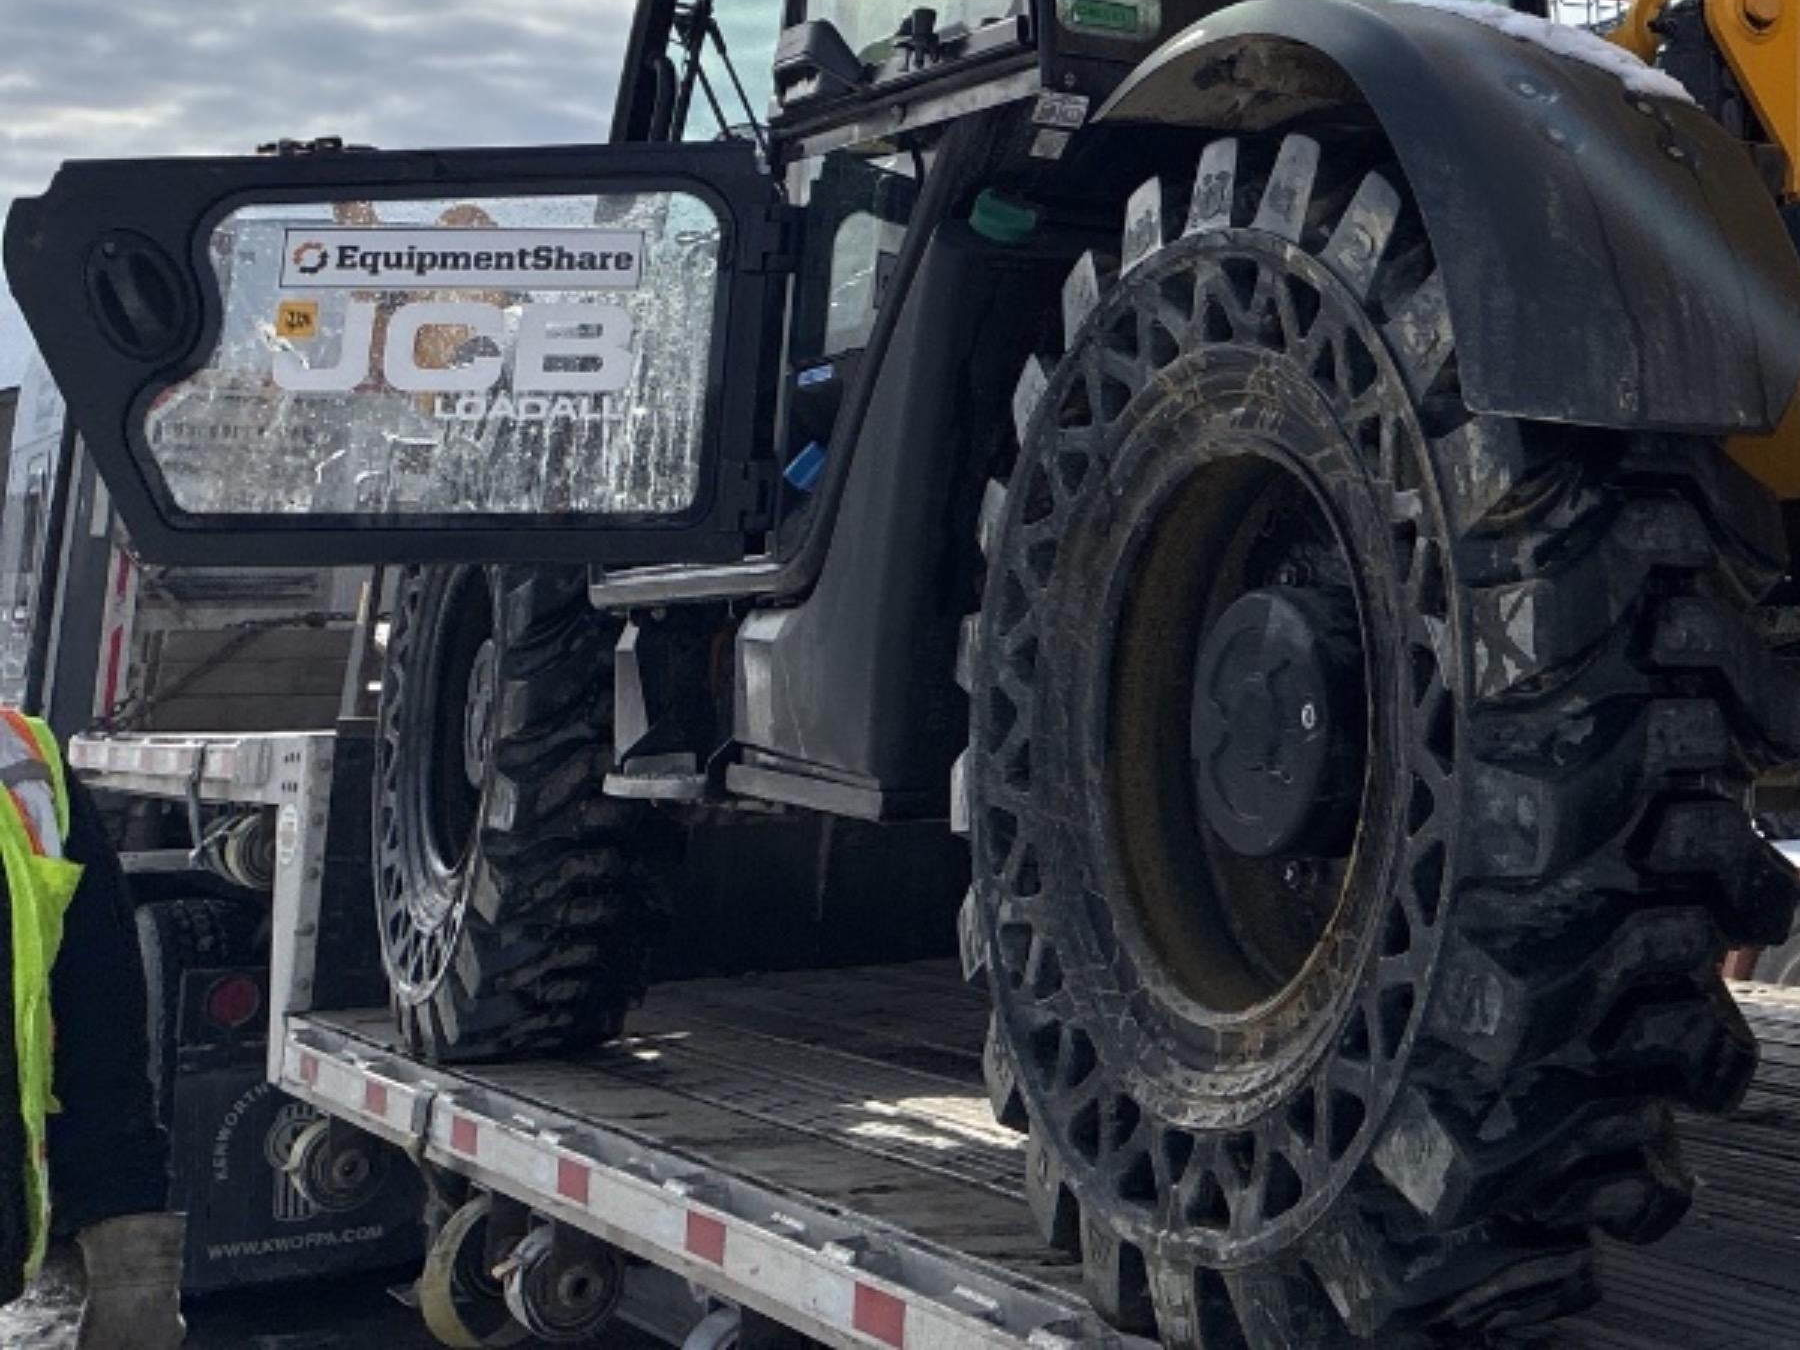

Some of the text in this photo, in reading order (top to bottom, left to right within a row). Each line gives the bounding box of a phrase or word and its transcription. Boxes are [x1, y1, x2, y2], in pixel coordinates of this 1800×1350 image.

[335, 244, 633, 276] EquipmentShare
[272, 300, 634, 392] JCB
[433, 395, 623, 421] LOADALL
